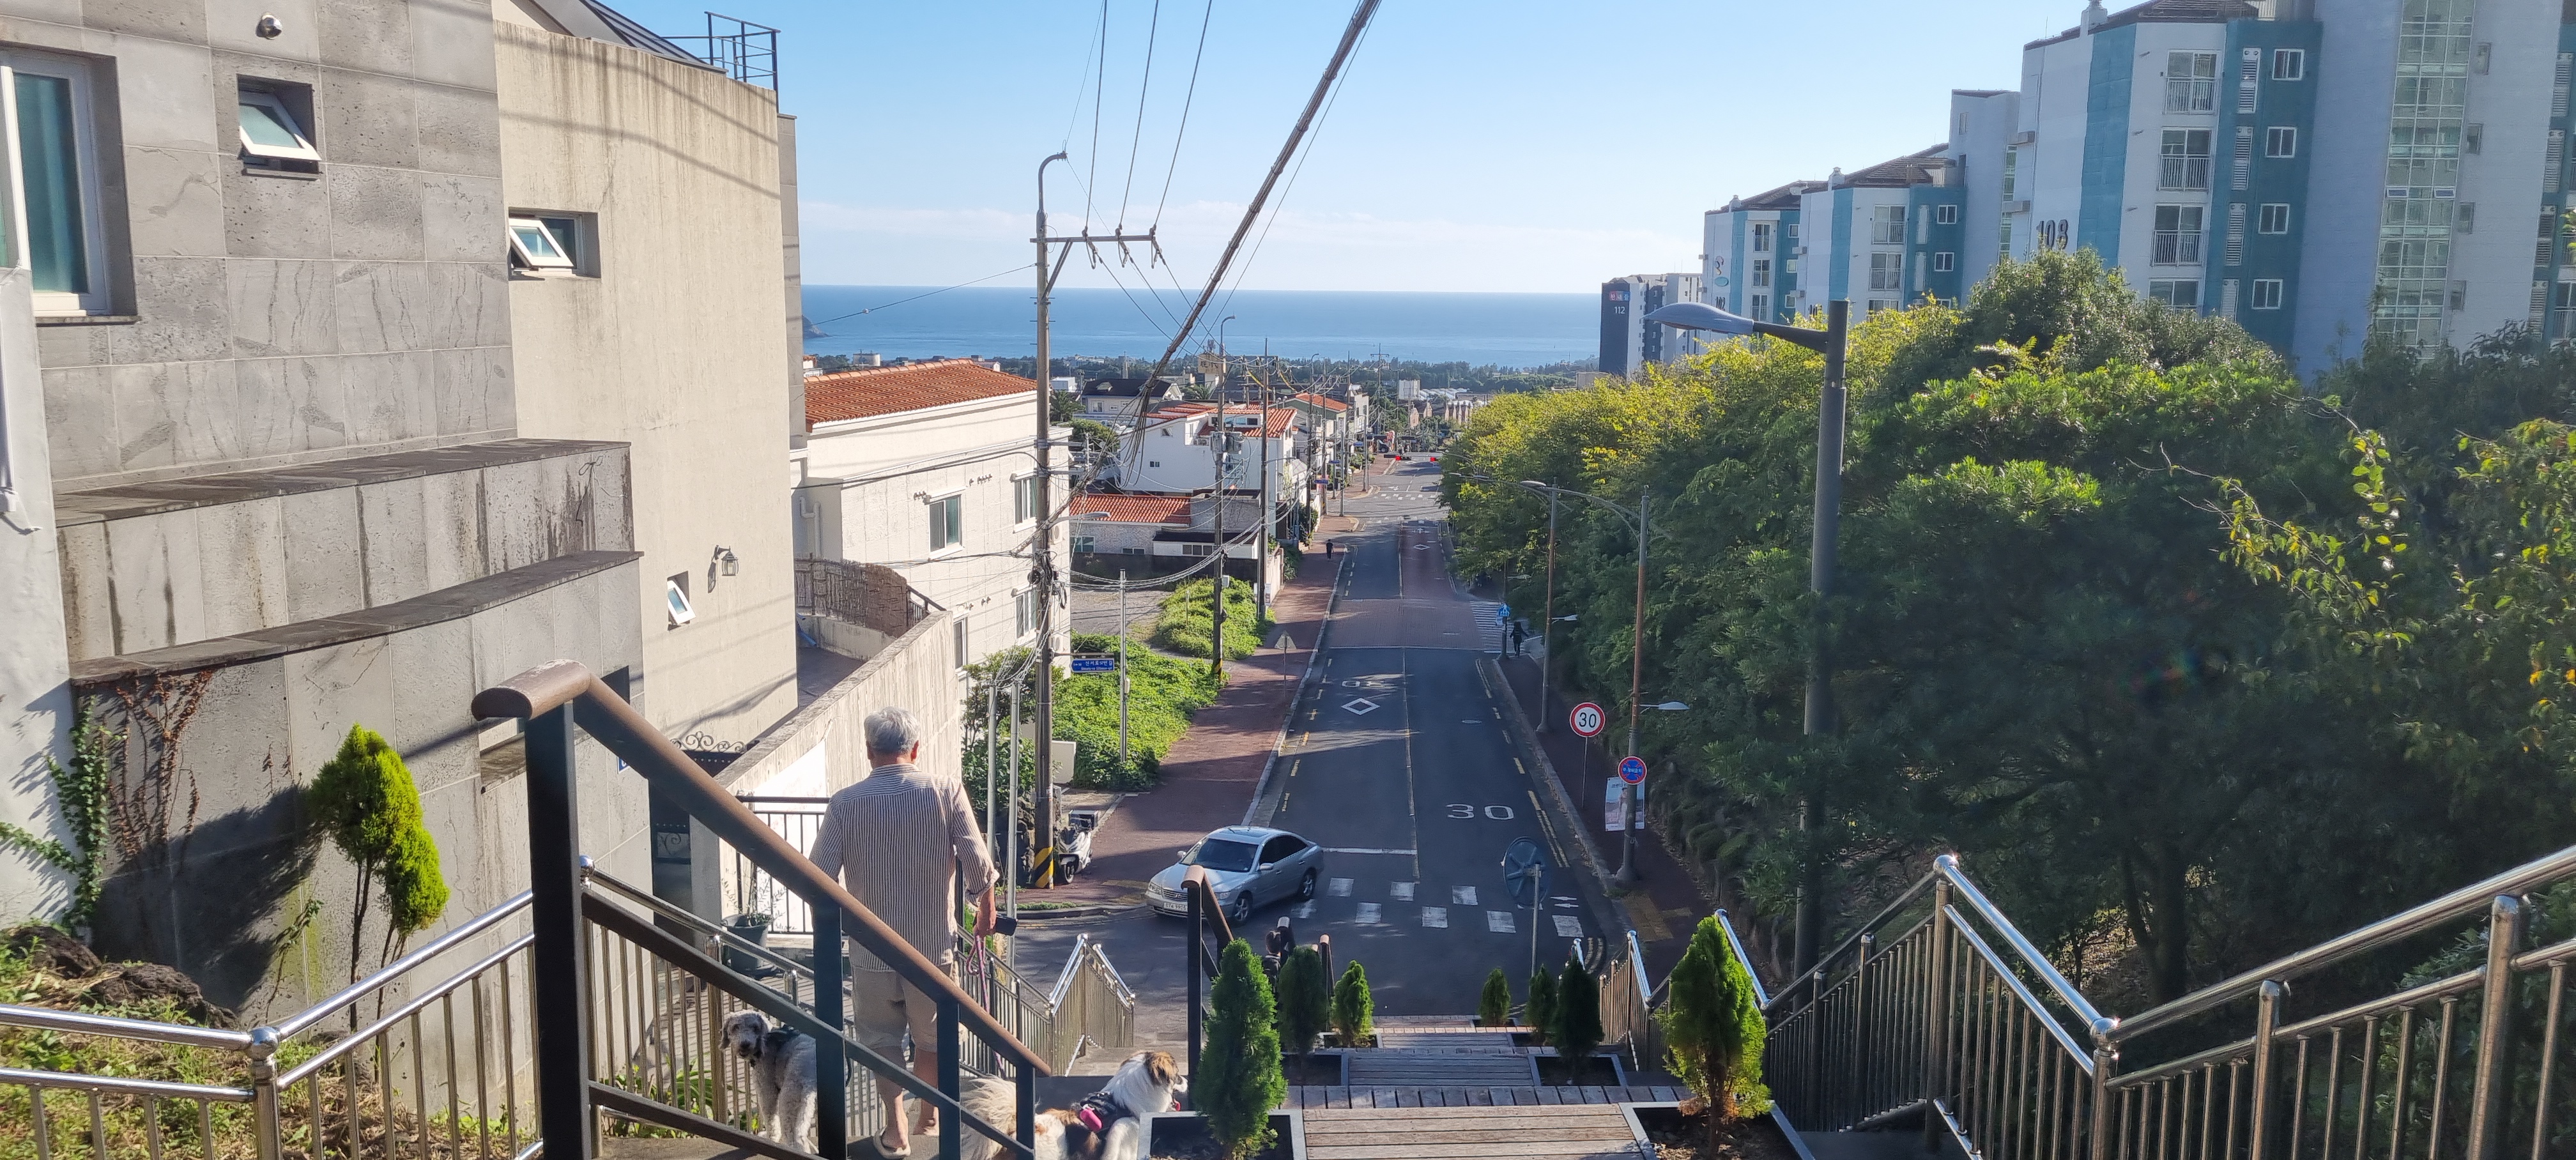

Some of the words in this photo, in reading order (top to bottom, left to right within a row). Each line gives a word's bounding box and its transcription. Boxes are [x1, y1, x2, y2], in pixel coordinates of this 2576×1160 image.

[1614, 306, 1625, 314] 112
[1579, 712, 1597, 728] 30
[1446, 804, 1514, 820] 30
